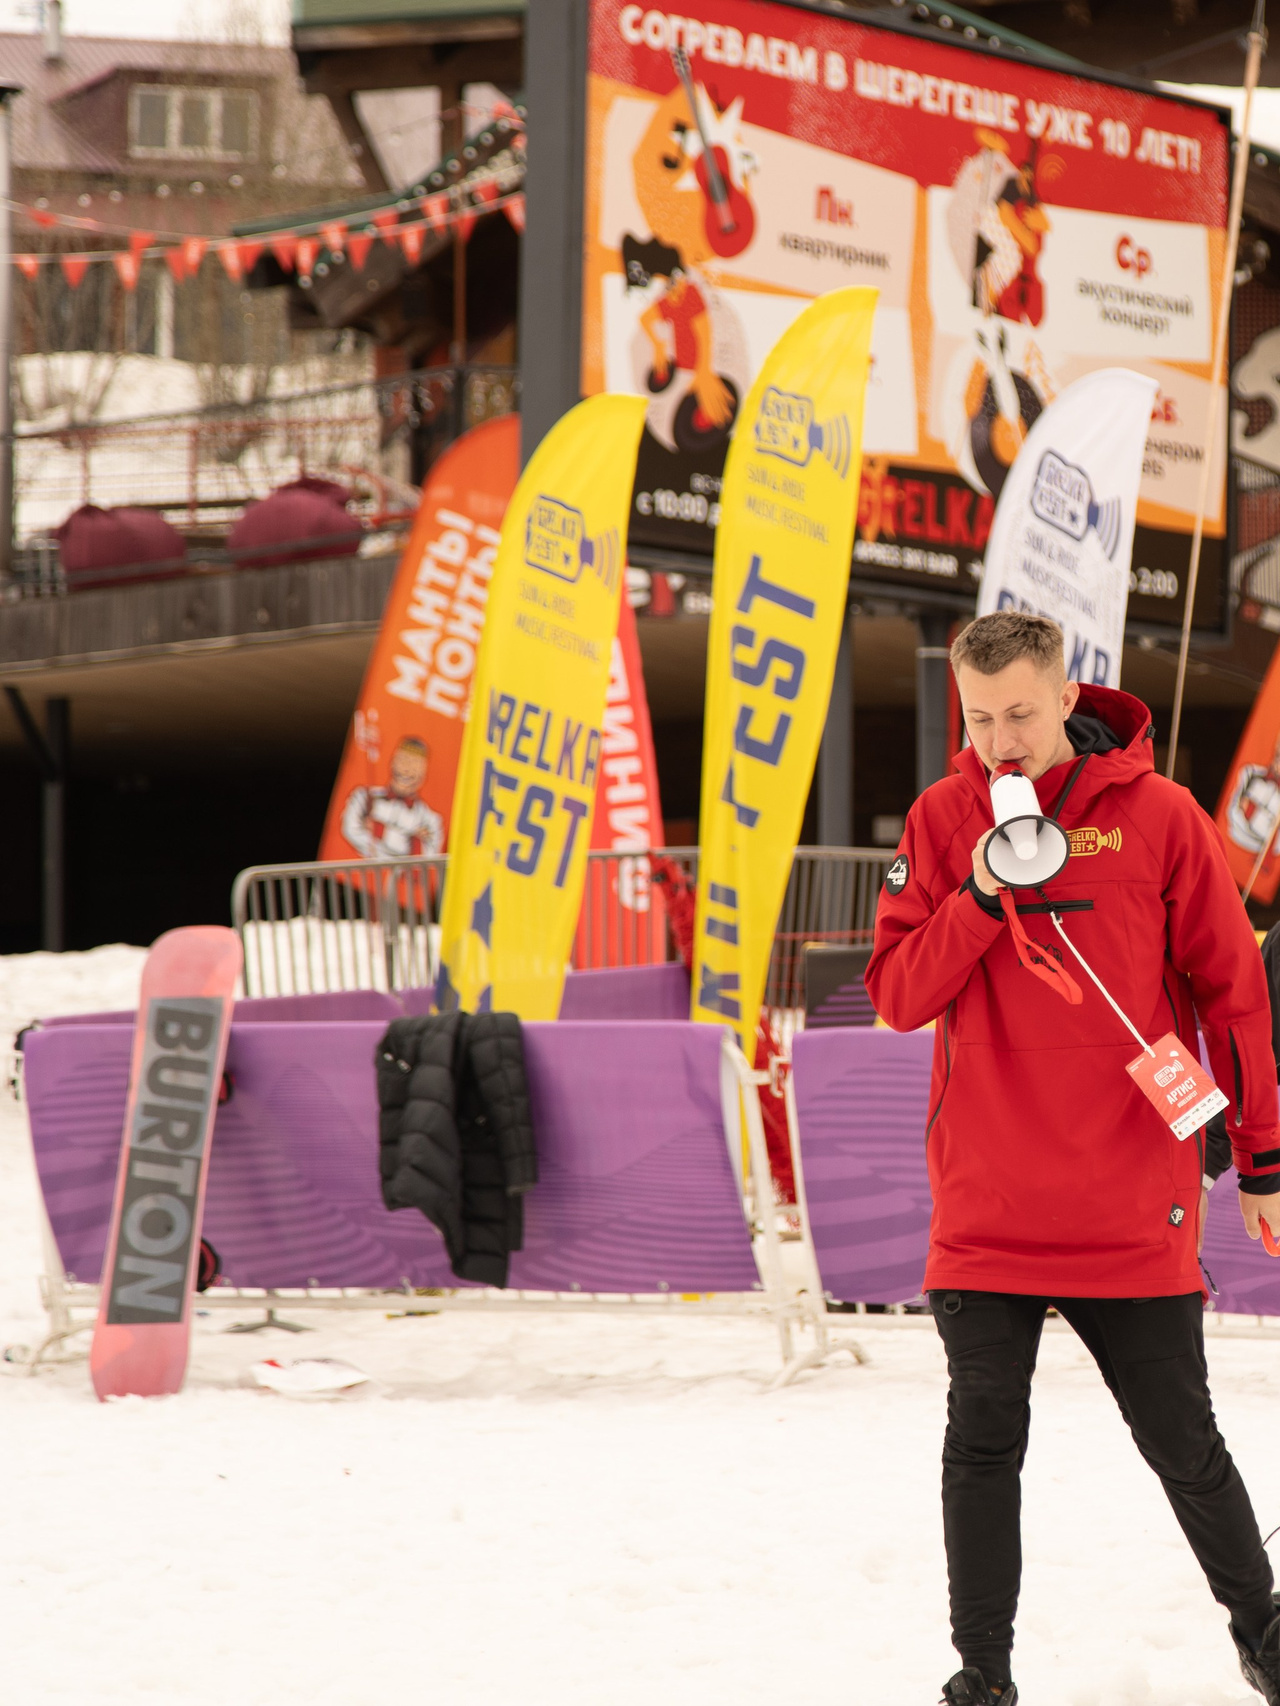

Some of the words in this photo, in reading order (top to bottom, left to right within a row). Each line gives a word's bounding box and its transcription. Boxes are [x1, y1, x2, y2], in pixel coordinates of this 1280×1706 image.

[619, 5, 818, 84] СОГРЕВАЕМ
[824, 51, 848, 91] В
[854, 57, 1020, 133] ШЕРЕГЕШЕ
[1024, 99, 1094, 150] УЖЕ
[1098, 118, 1131, 159] 10
[1134, 127, 1202, 175] ЛЕТ!
[385, 507, 475, 703] МАНТЫ
[422, 523, 503, 718] ПОНТЫ
[1069, 842, 1087, 852] EST
[114, 1006, 218, 1315] BURTON
[1166, 1076, 1197, 1105] АРТИСТ
